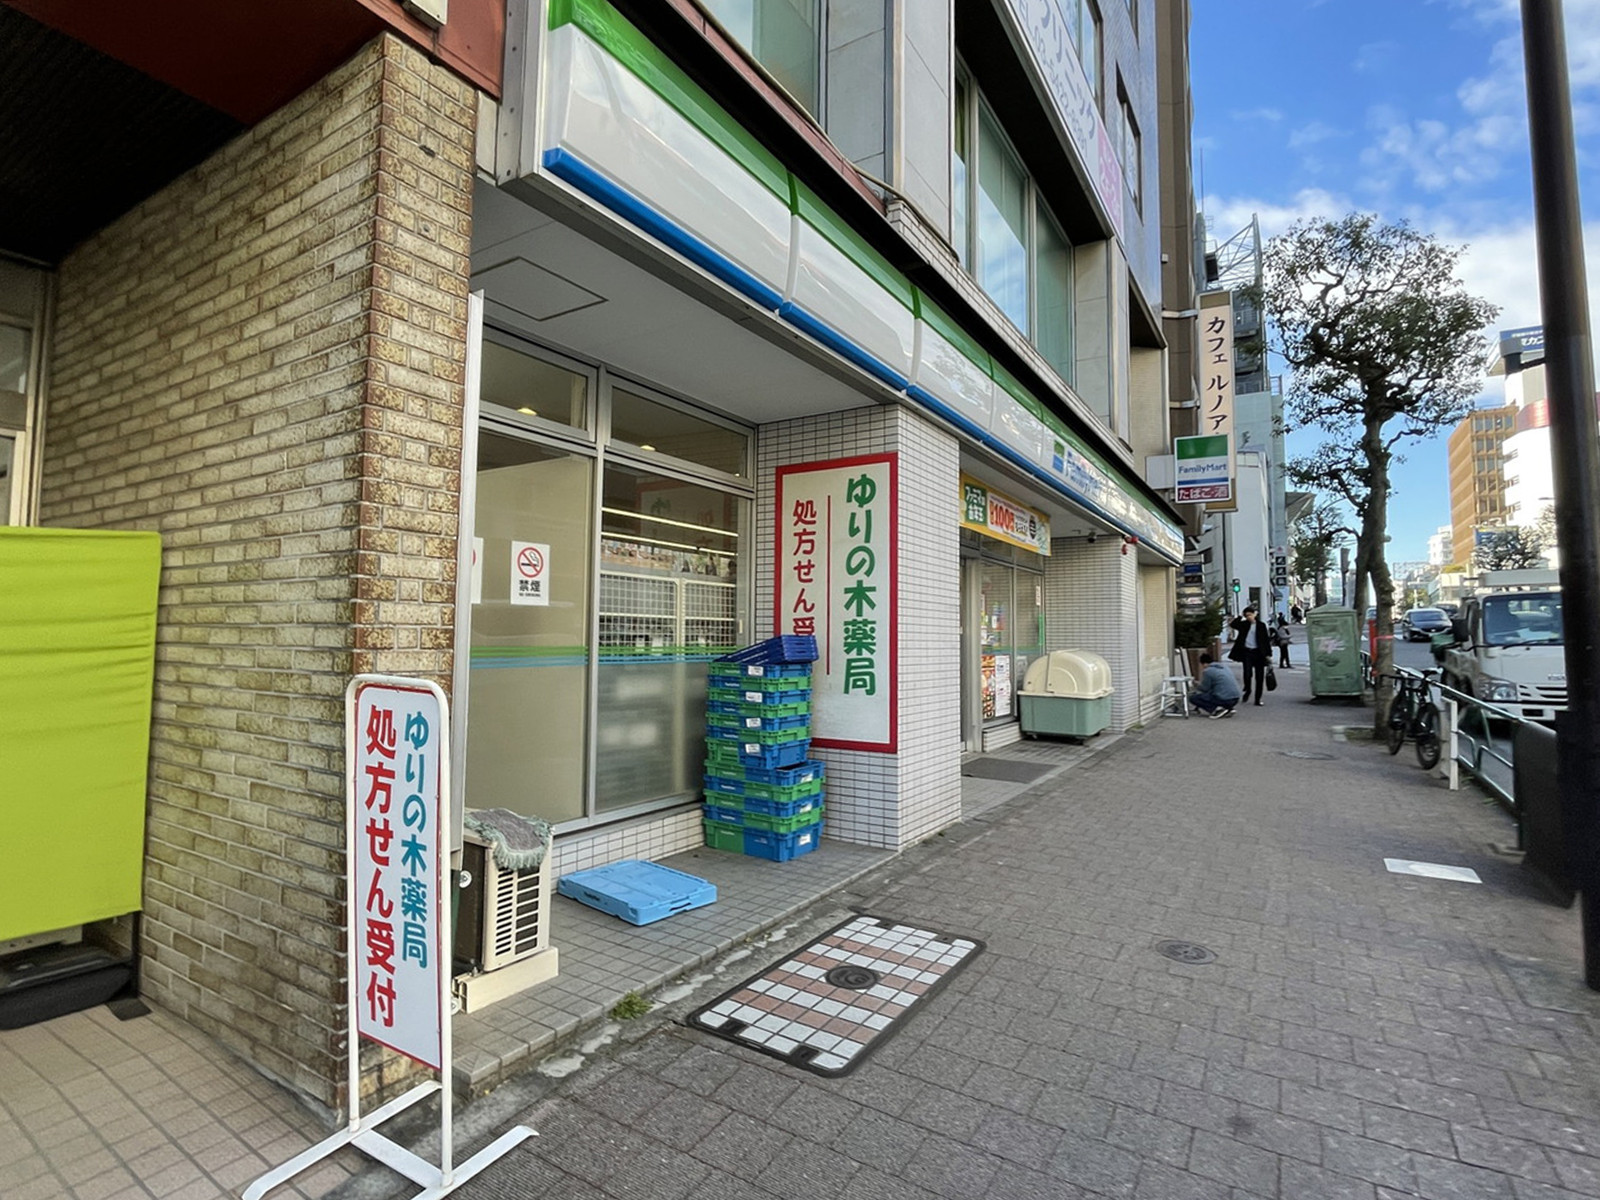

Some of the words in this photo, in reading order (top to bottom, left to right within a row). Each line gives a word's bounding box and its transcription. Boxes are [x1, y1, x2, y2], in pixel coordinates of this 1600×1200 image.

[1206, 316, 1228, 364] カフェ
[1206, 374, 1230, 435] ルノア
[1178, 463, 1227, 474] FamilyMart
[519, 579, 540, 592] 禁煙
[843, 473, 877, 696] ゆりの木薬局
[364, 705, 398, 1029] 処方せん受付
[400, 710, 430, 969] ゆりの木薬局
